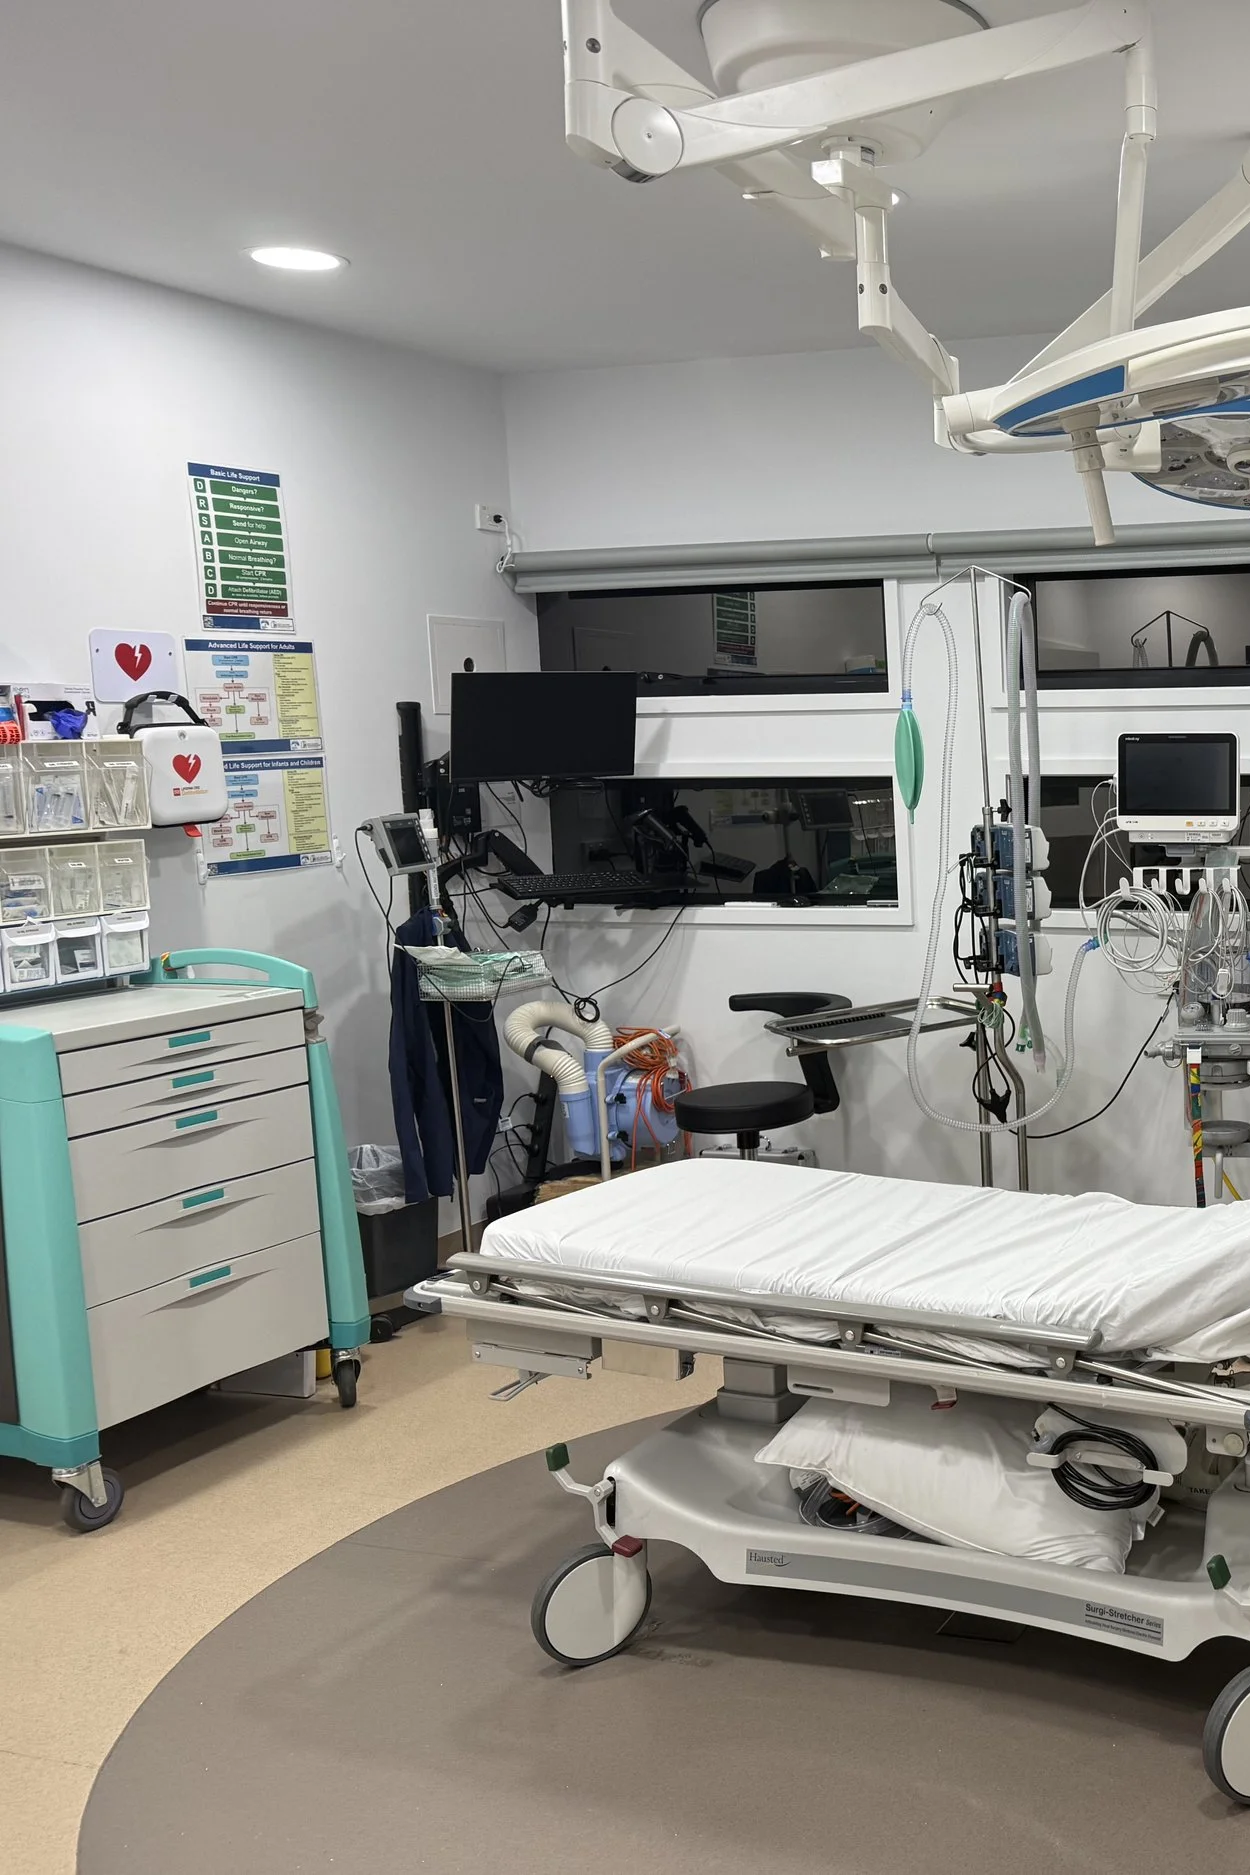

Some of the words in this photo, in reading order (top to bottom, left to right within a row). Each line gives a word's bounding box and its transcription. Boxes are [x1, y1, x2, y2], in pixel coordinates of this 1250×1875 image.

[210, 468, 226, 477] Basic
[238, 472, 260, 481] Support
[197, 481, 203, 490] D
[232, 486, 257, 495] Dangers?
[200, 500, 206, 508] R
[229, 503, 264, 512] Responsive?
[202, 517, 208, 525] S
[204, 534, 211, 542] A
[250, 539, 268, 547] Airway
[206, 552, 212, 560] B
[248, 556, 276, 564] Breathing?
[750, 1552, 784, 1564] Hausted
[1086, 1603, 1144, 1624] Surgi-Stretcher
[1146, 1619, 1161, 1628] Series
